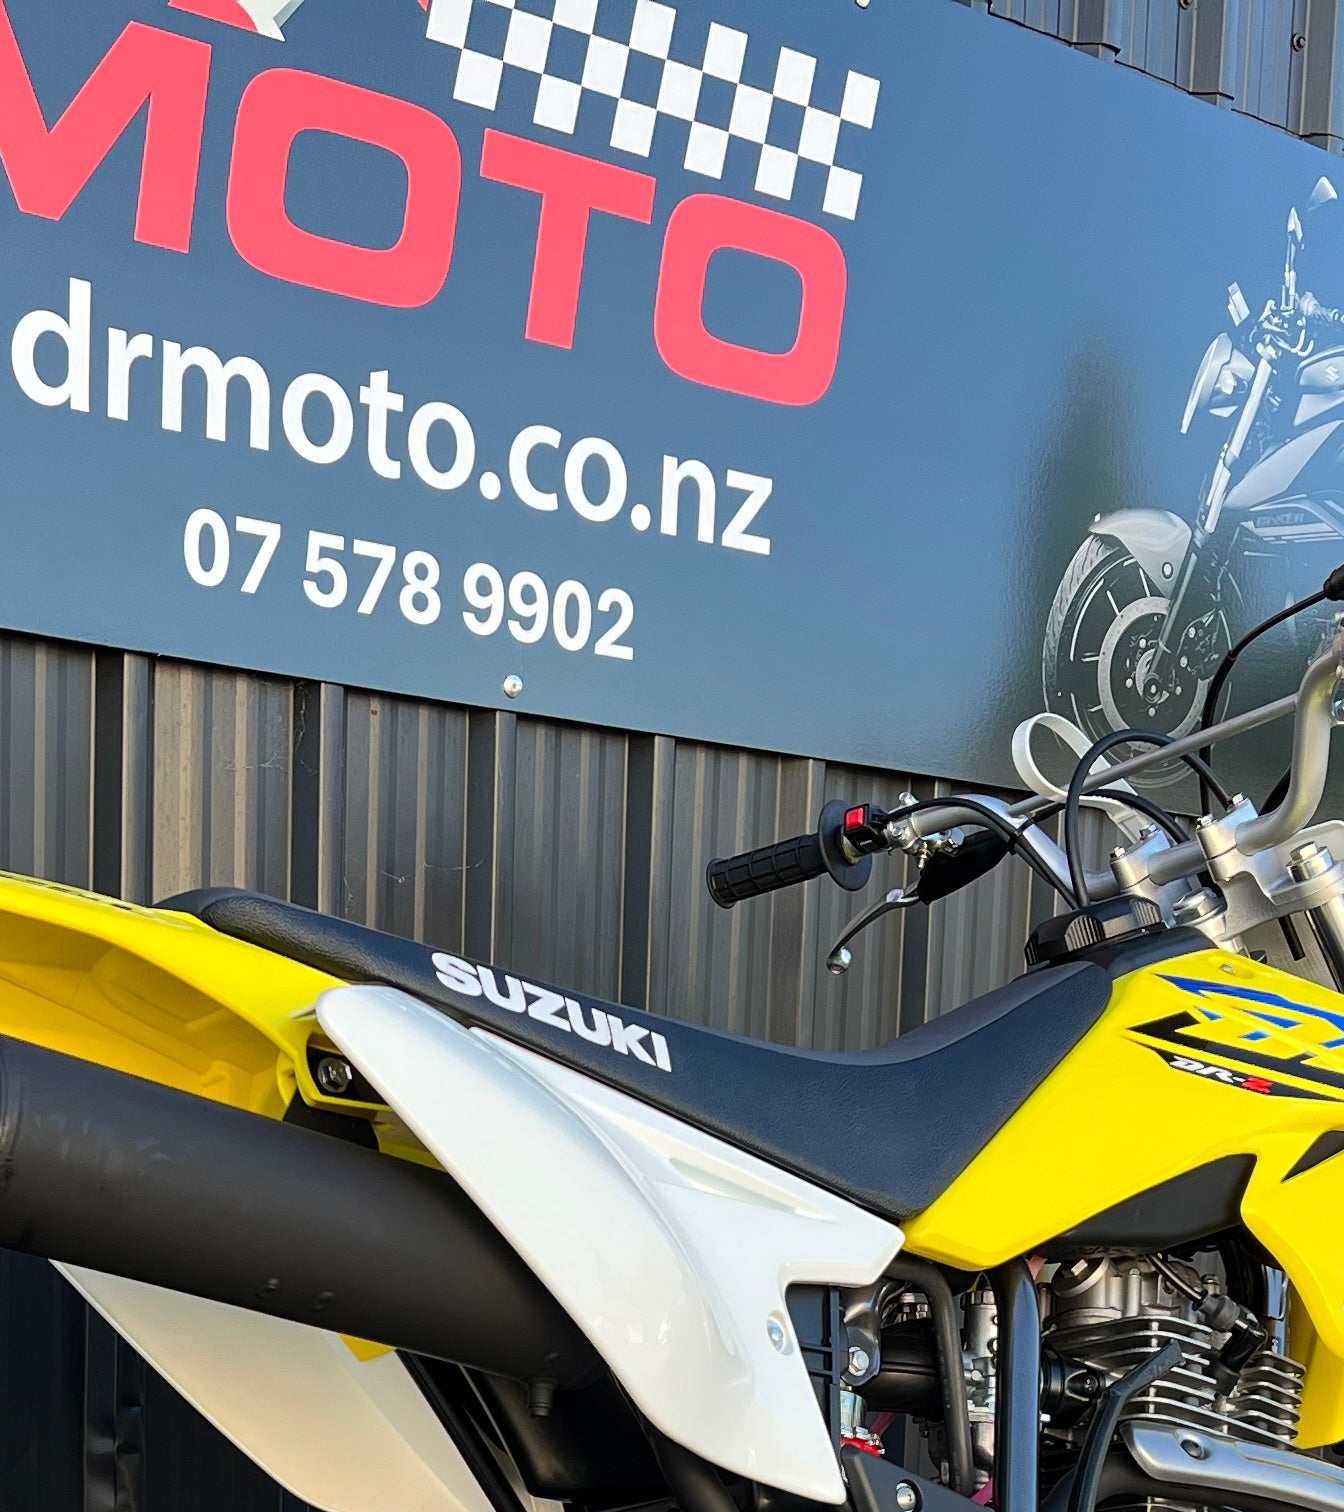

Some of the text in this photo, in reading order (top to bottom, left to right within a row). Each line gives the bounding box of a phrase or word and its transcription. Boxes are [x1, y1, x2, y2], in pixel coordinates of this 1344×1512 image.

[11, 277, 773, 556] drmoto.co.nz
[183, 508, 635, 661] 07 578 9902
[431, 951, 672, 1073] SUZUKI
